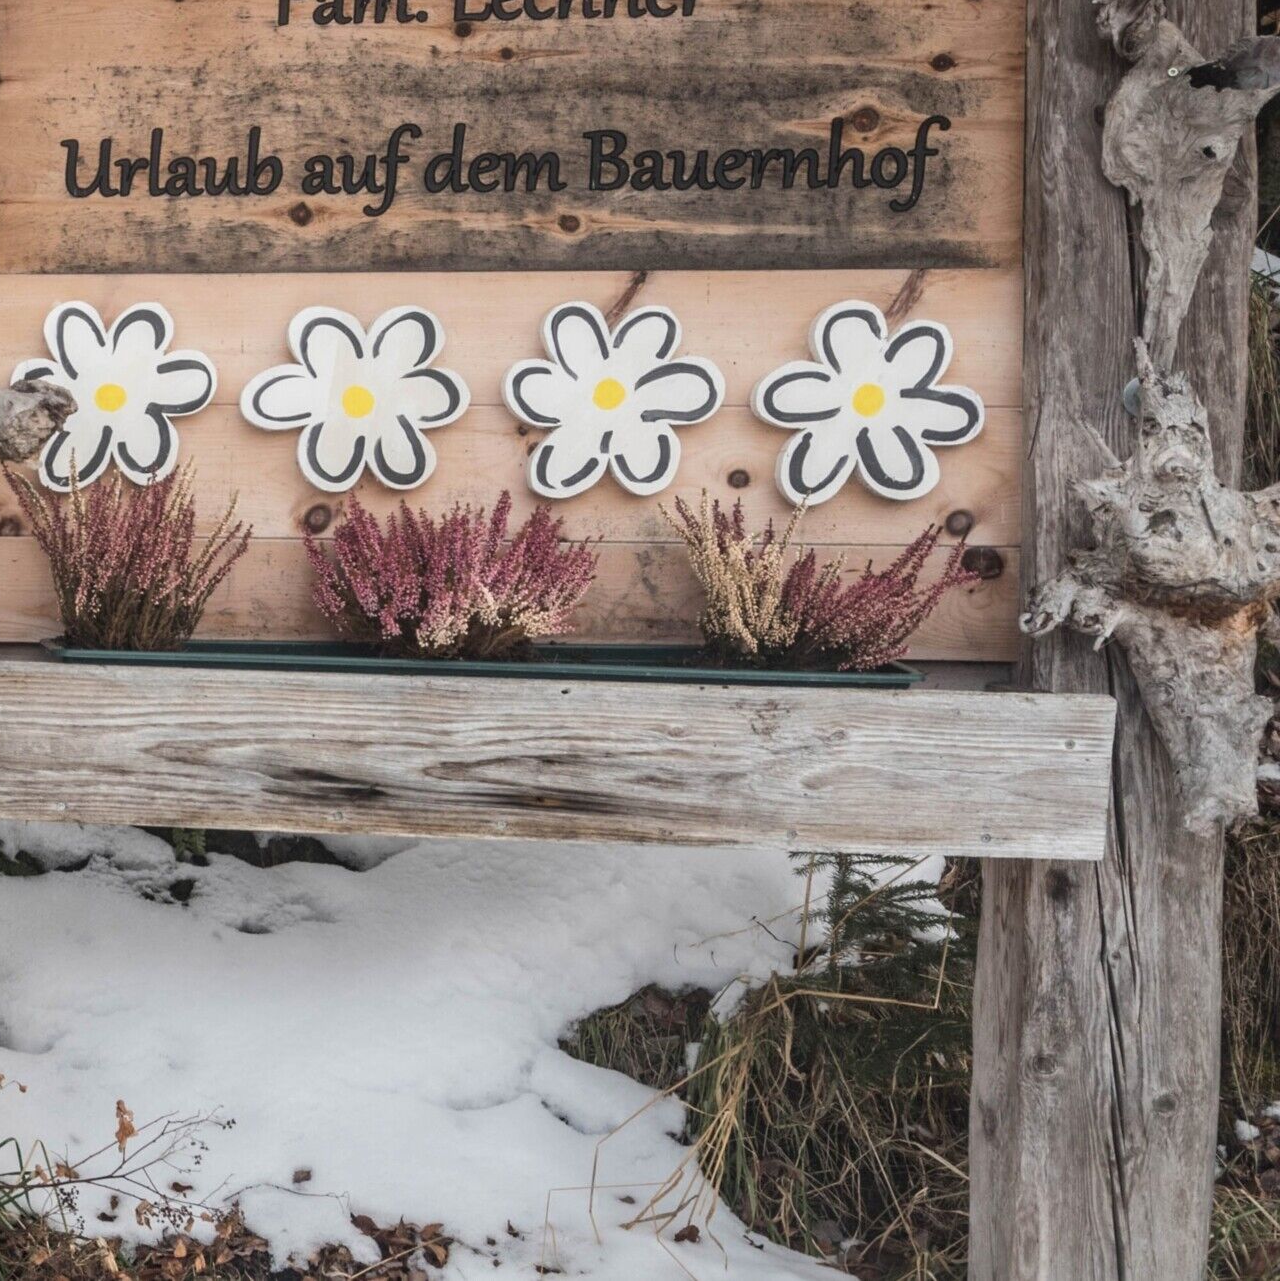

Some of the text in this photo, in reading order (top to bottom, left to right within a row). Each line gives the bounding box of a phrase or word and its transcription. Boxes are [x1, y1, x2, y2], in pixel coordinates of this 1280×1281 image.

[60, 116, 951, 217] Urlaub auf dem Bauernhof
